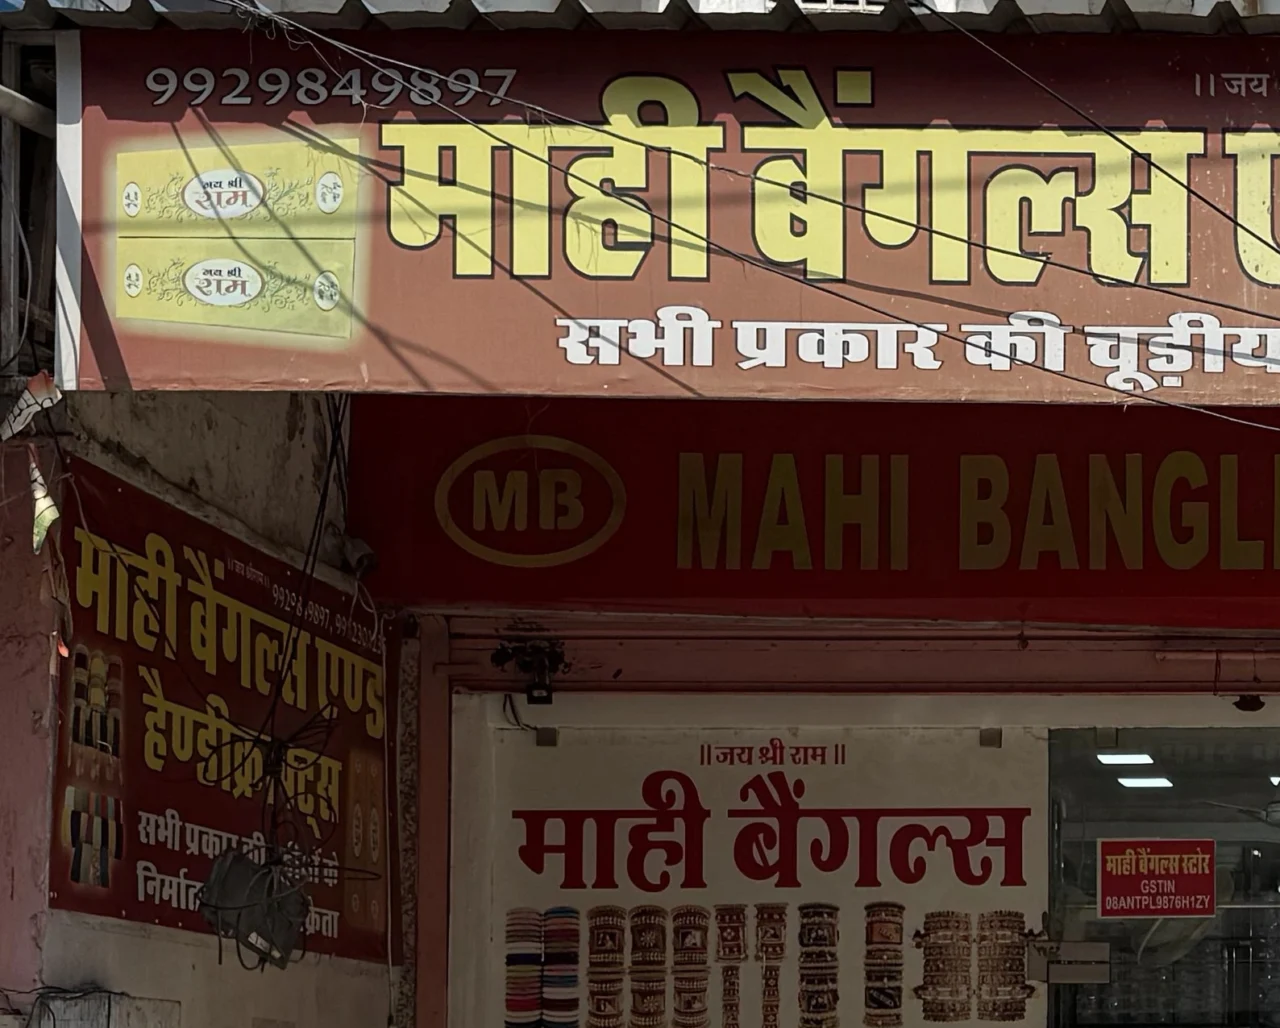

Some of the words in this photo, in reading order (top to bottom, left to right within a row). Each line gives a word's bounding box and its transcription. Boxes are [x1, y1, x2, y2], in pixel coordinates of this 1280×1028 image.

[144, 66, 518, 108] 9929849897
[379, 73, 725, 281] माही
[722, 64, 1206, 287] बैंगल्स
[194, 278, 250, 297] राम
[555, 304, 723, 369] सभी
[732, 319, 946, 371] प्रकार
[961, 311, 1075, 372] की
[472, 468, 586, 532] MB
[676, 452, 910, 571] MAHI
[73, 526, 182, 660] माही
[183, 544, 311, 712] बैंगल्स
[314, 635, 387, 741] एण्ड
[137, 808, 183, 852] सभी
[512, 770, 711, 893] माही
[727, 770, 1032, 889] बैंगल्स
[1105, 848, 1137, 876] माही
[1181, 847, 1211, 876] स्टोर
[1105, 894, 1211, 910] 08ANTPL9876H1ZY
[1140, 879, 1176, 894] GSTIN
